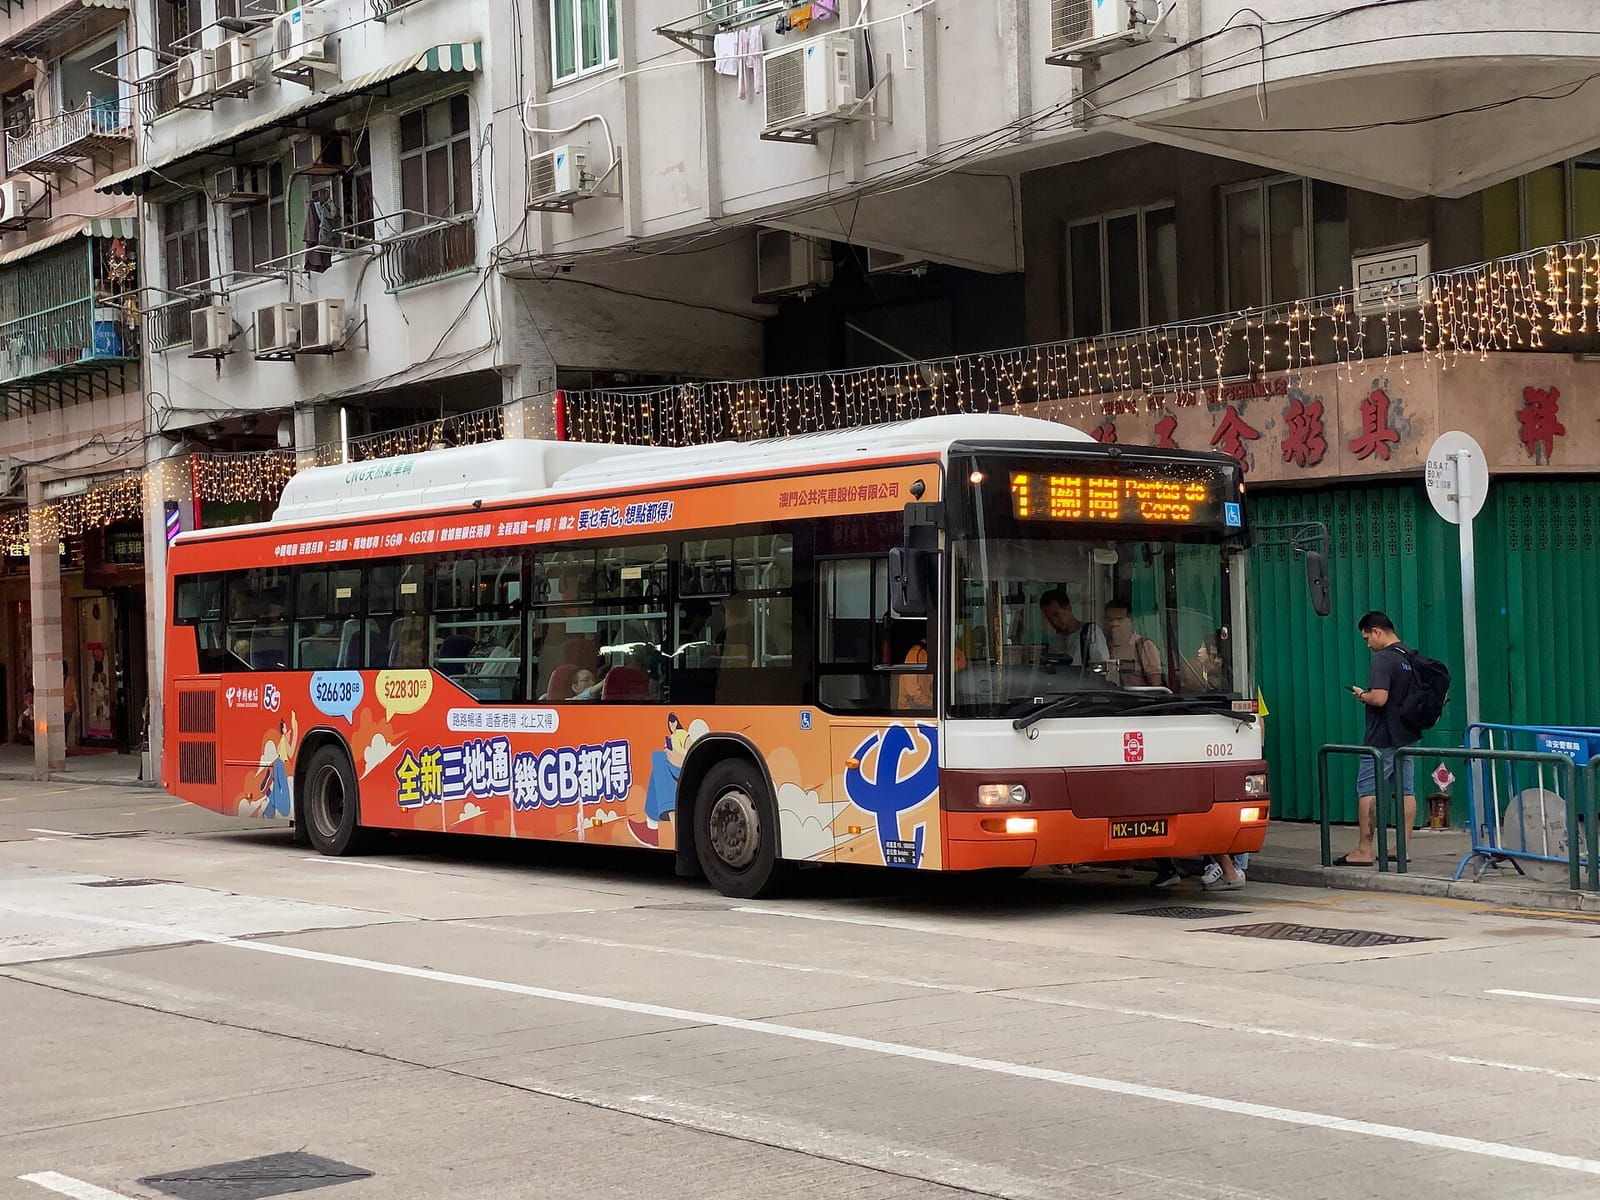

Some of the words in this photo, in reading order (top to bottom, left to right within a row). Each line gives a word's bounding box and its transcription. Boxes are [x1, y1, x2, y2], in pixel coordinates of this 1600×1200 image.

[778, 482, 900, 508] 澳門公共汽車股份有限公司
[1012, 475, 1028, 516] 1
[264, 684, 281, 712] 5G
[520, 713, 553, 729] 北上又得
[1206, 743, 1233, 757] 6002
[396, 737, 512, 808] 全新三地通
[513, 743, 631, 808] 幾GB都得
[1112, 821, 1165, 837] MX-10-41
